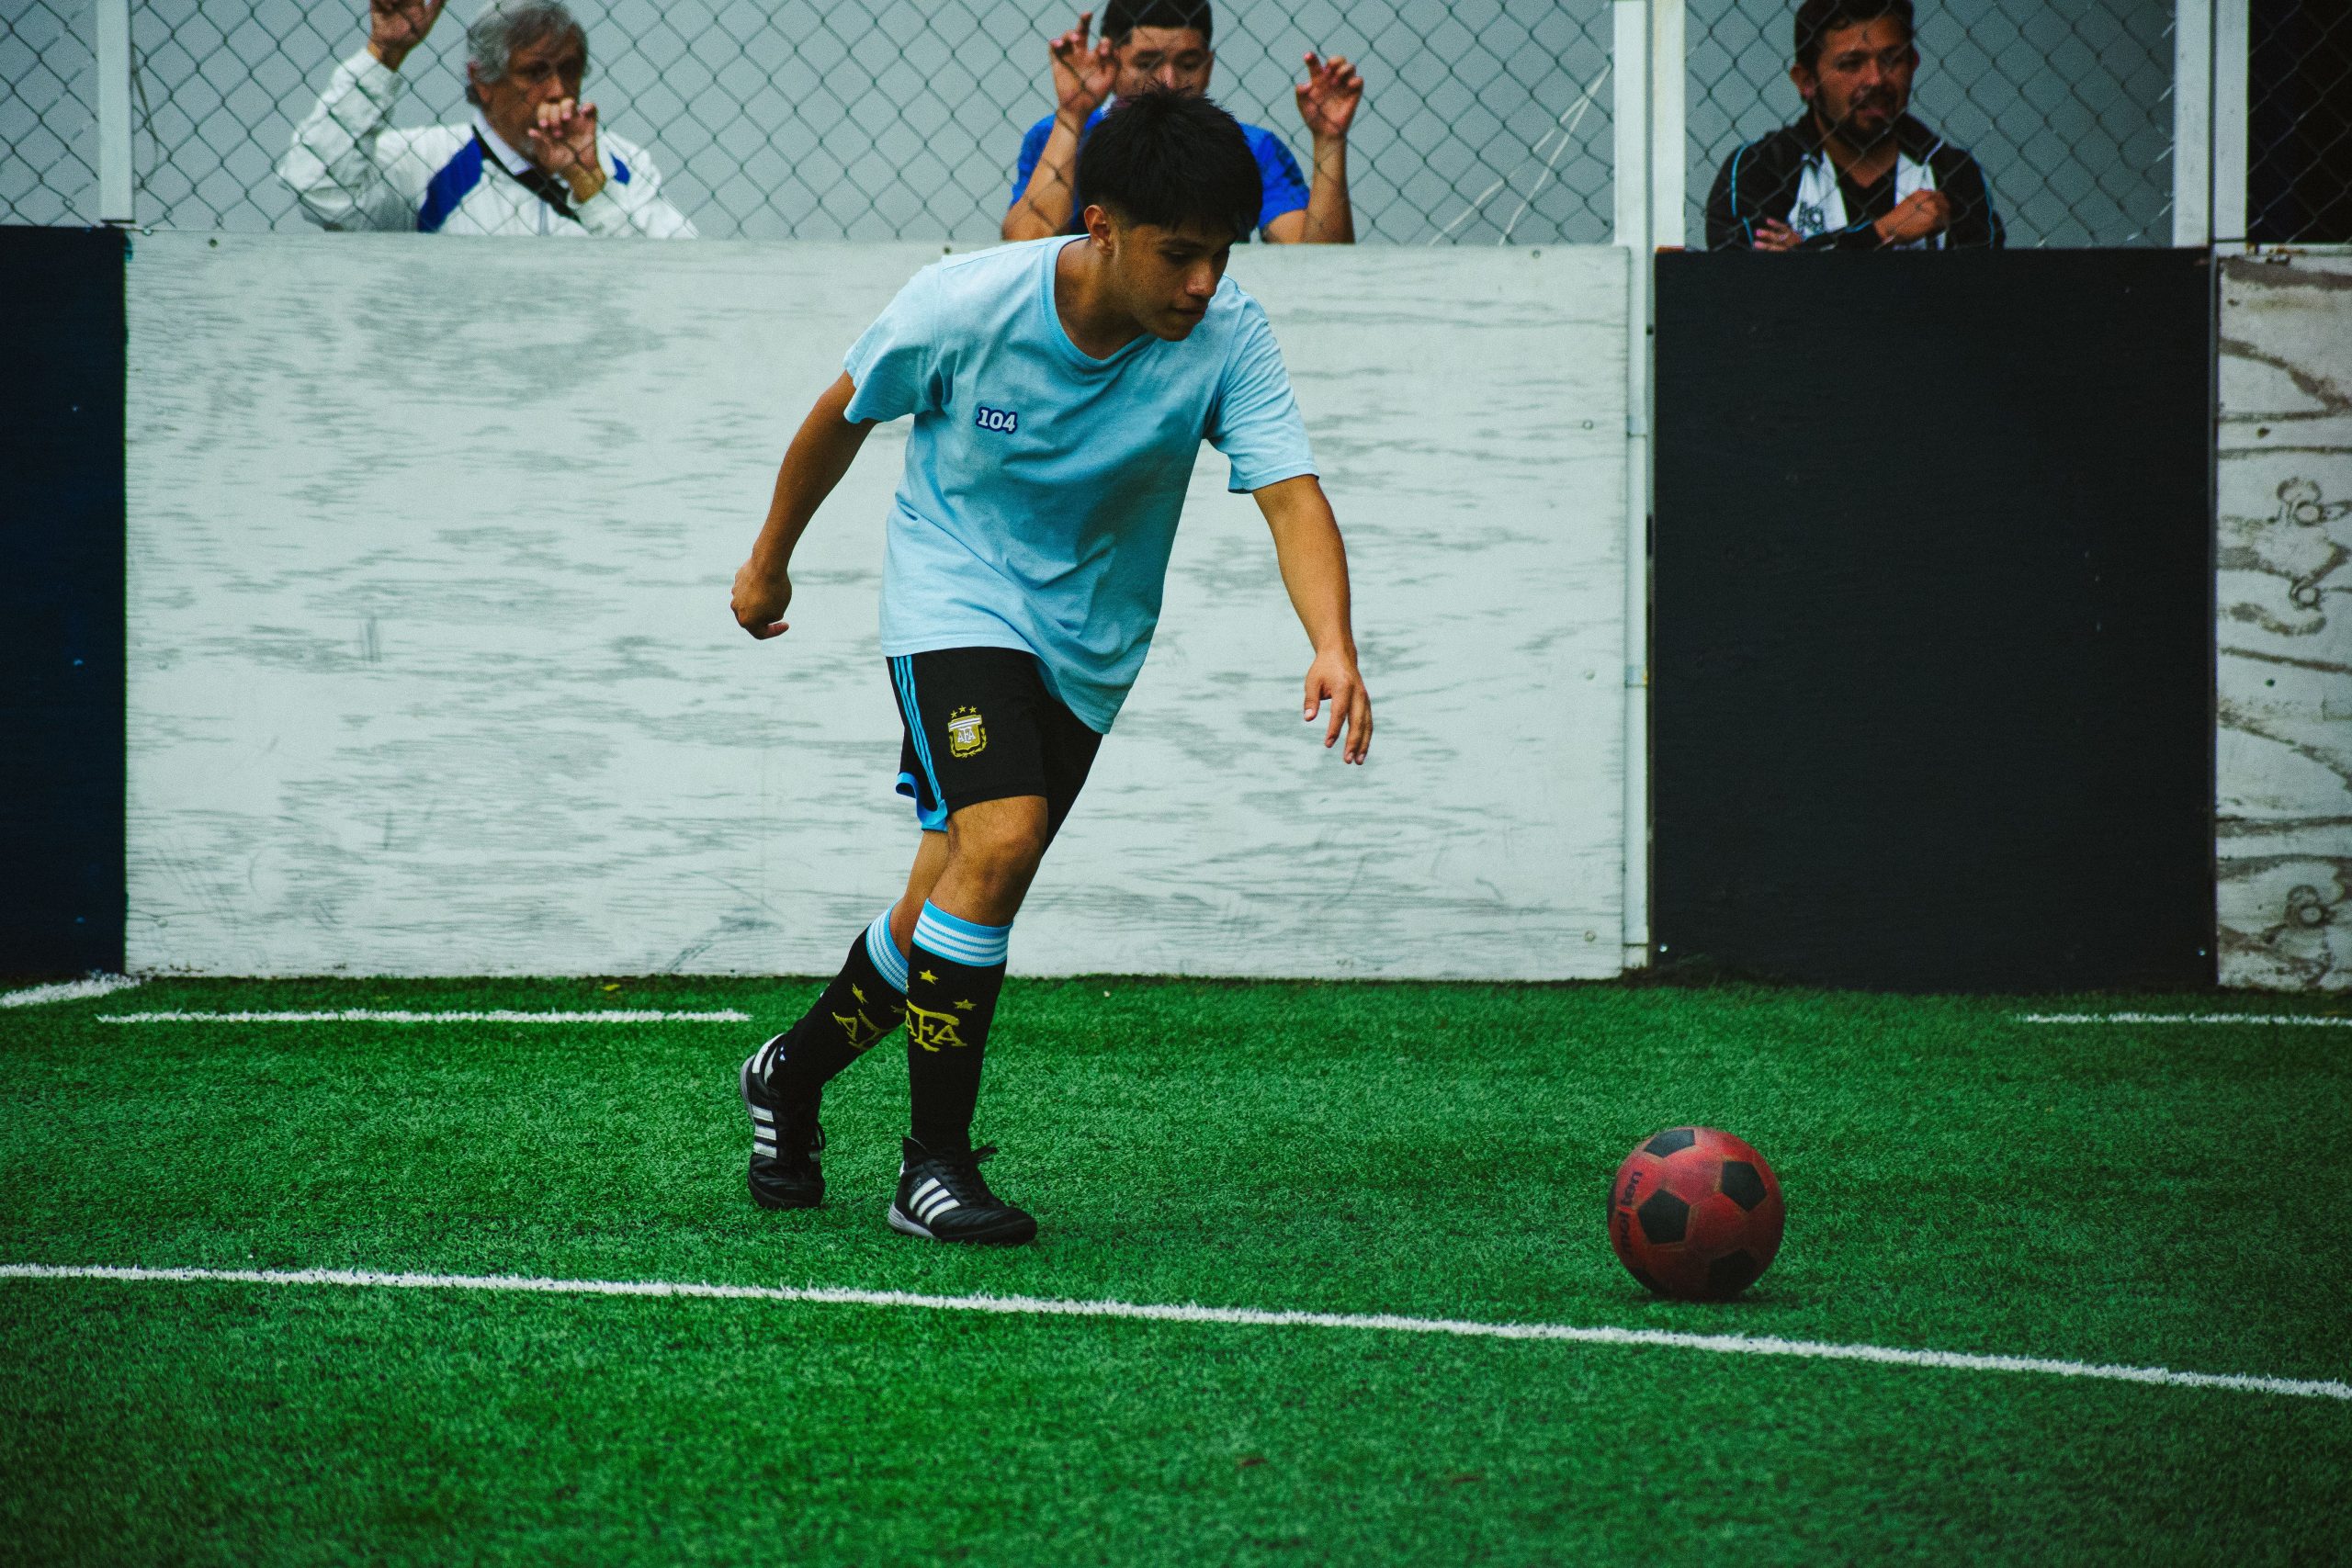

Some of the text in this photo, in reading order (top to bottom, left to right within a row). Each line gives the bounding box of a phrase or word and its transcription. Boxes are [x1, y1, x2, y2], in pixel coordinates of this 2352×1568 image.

[977, 407, 1017, 434] 104
[957, 727, 976, 743] AFA
[906, 999, 967, 1053] AFA
